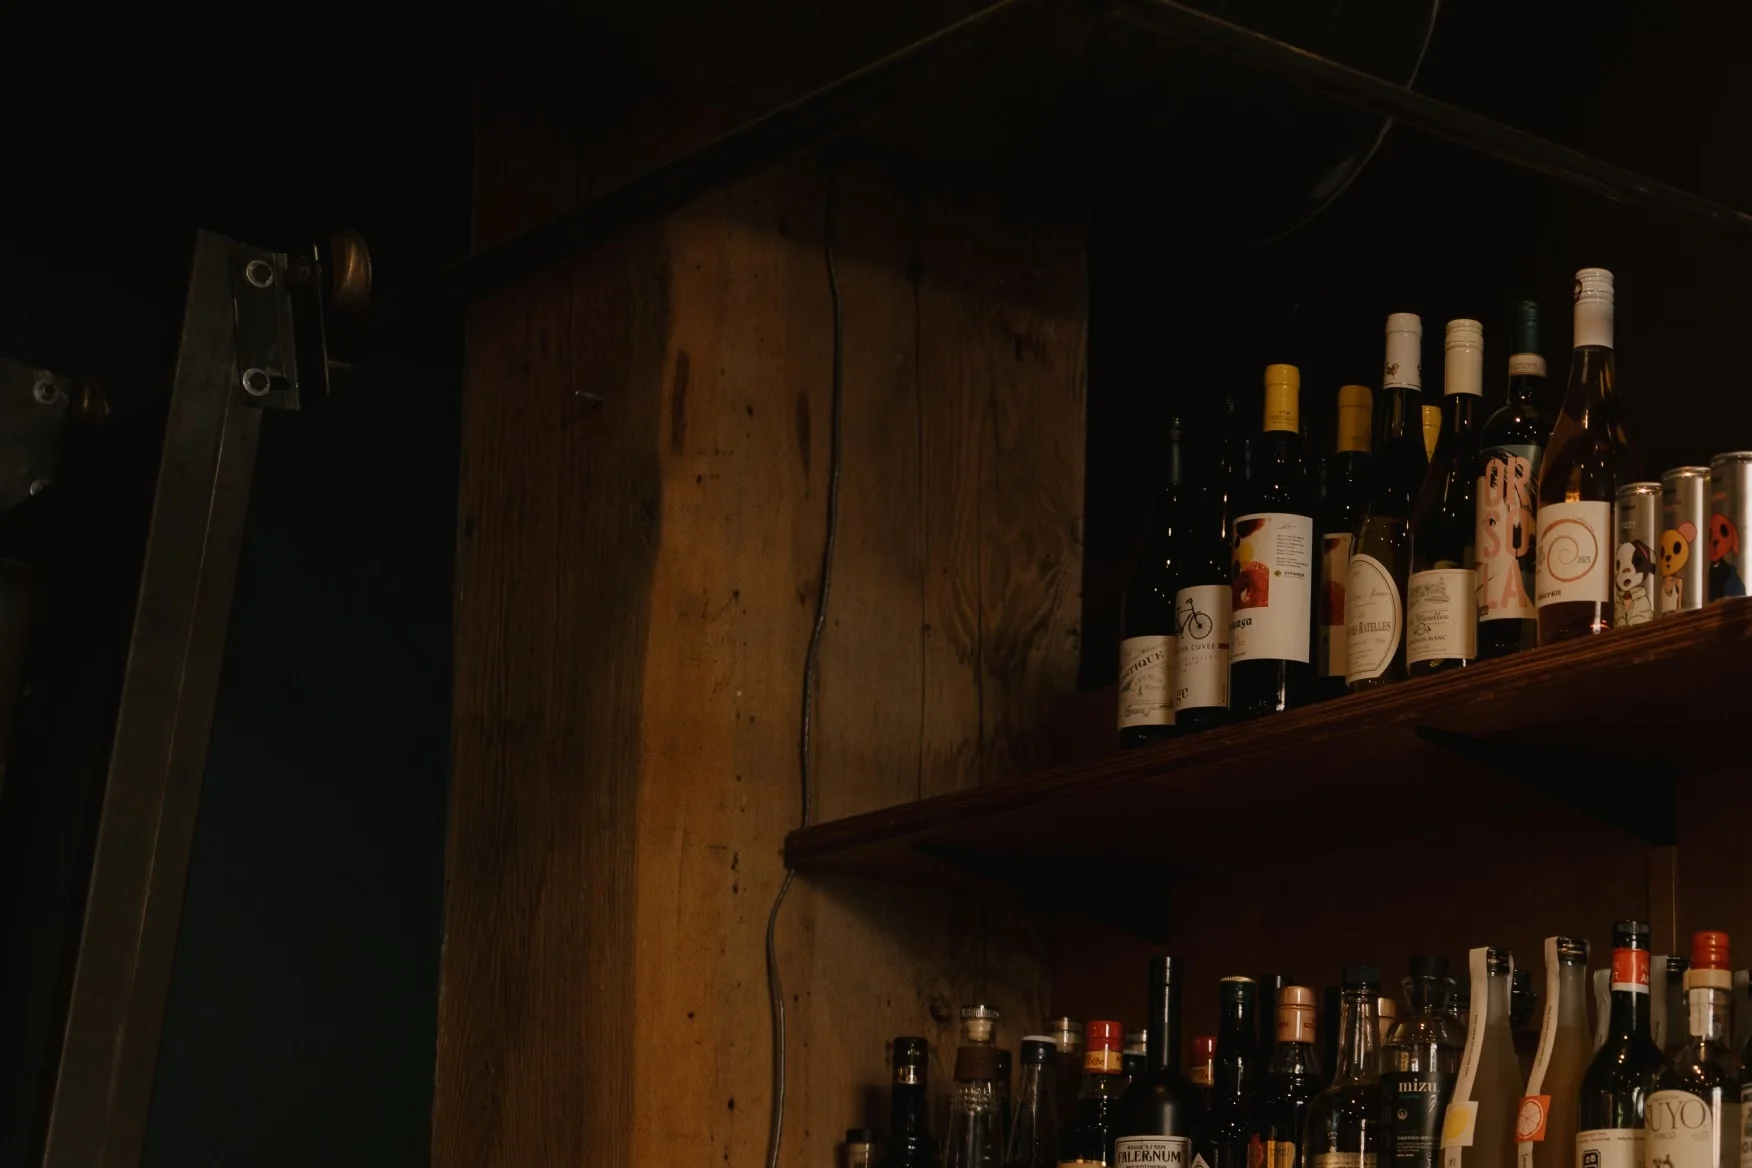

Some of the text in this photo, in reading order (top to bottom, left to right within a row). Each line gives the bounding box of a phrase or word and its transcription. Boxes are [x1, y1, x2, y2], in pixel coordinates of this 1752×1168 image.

[1359, 620, 1392, 633] RATELLES
[1120, 651, 1165, 686] STIQUE
[1398, 1078, 1438, 1093] mizu
[1117, 1150, 1181, 1163] FALERNUM
